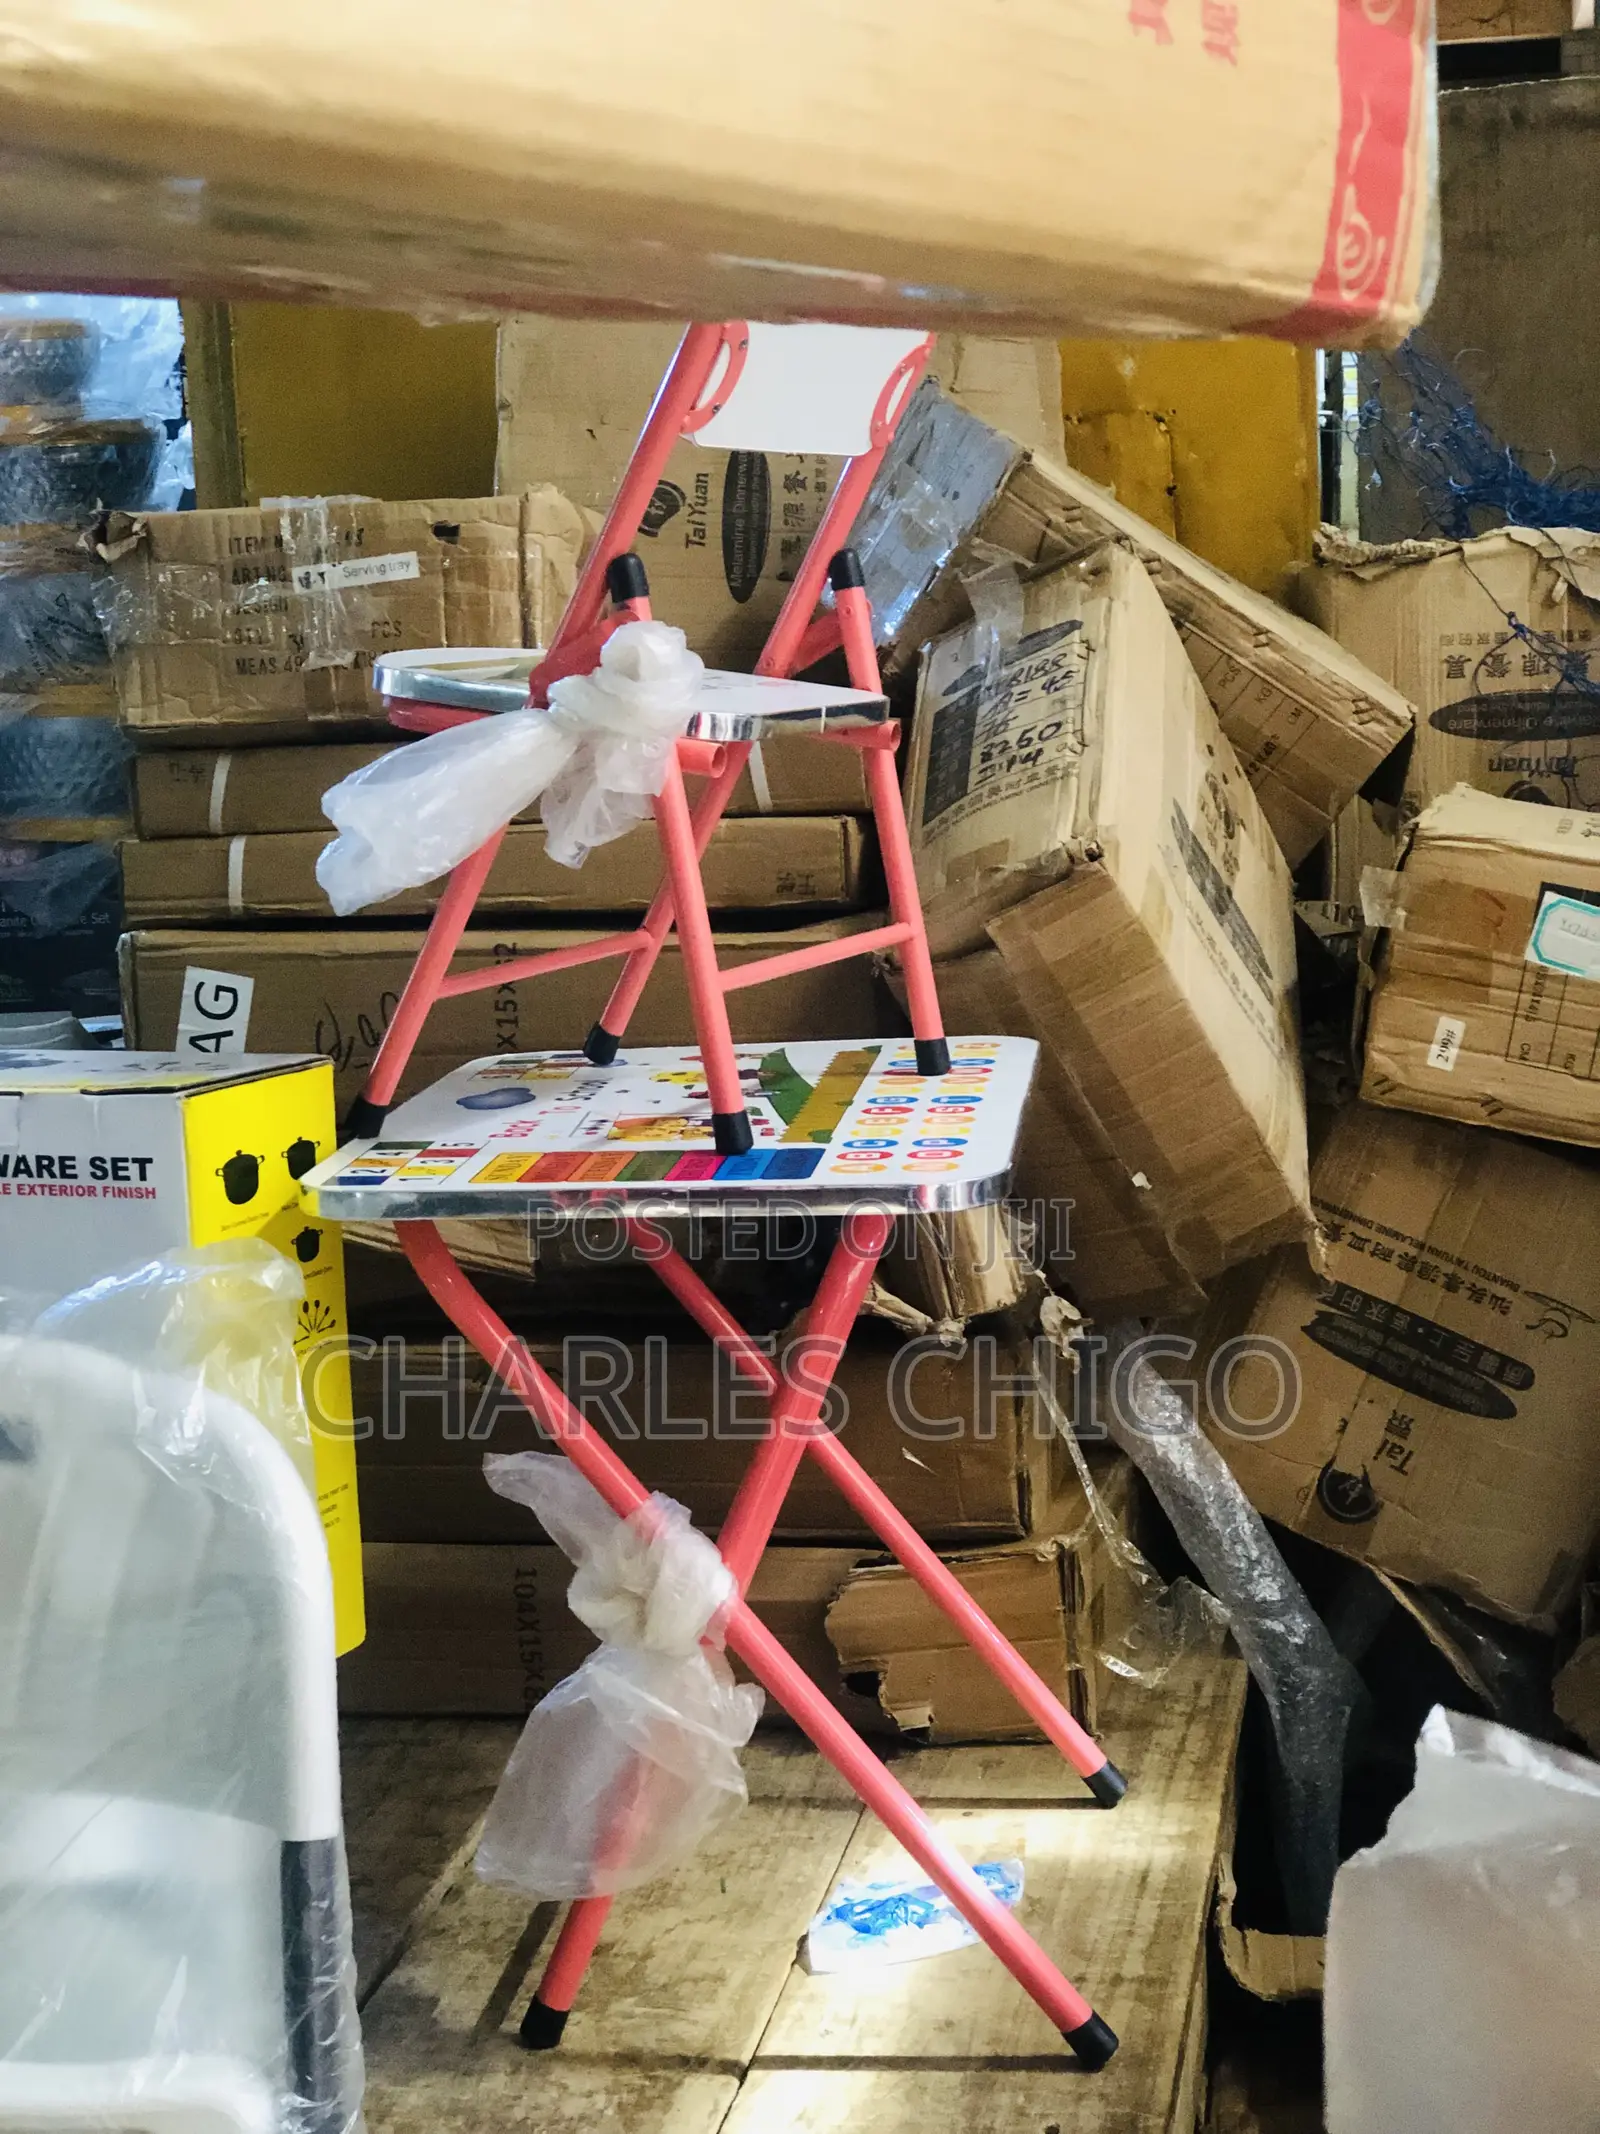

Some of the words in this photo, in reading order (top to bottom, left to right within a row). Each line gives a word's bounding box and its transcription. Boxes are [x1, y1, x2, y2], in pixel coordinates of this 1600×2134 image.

[730, 518, 745, 588] Melamine
[342, 561, 387, 579] Serving
[388, 559, 412, 575] tray
[89, 1156, 154, 1182] SET
[16, 1183, 98, 1198] EXTERIOR
[102, 1186, 157, 1200] FINISH
